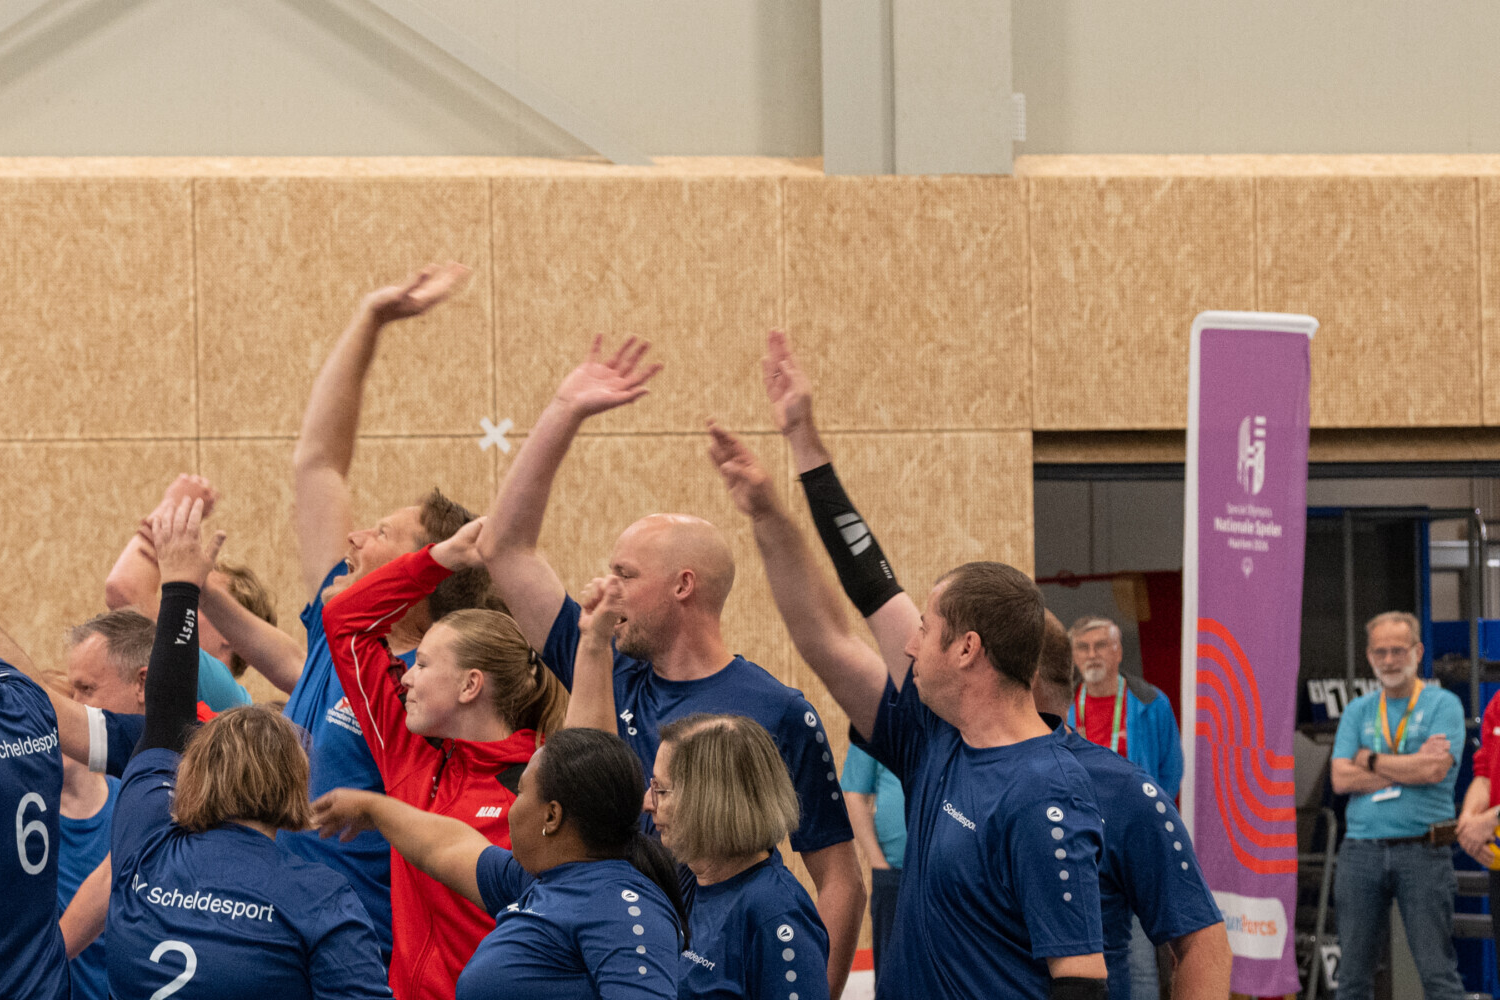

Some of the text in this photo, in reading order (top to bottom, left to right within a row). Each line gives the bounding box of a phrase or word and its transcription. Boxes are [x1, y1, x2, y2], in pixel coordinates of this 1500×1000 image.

[1214, 517, 1254, 535] Nationale
[175, 608, 196, 644] KIPSTA
[475, 806, 502, 818] ALBA
[16, 792, 50, 875] 6
[147, 887, 275, 923] Scheldesport
